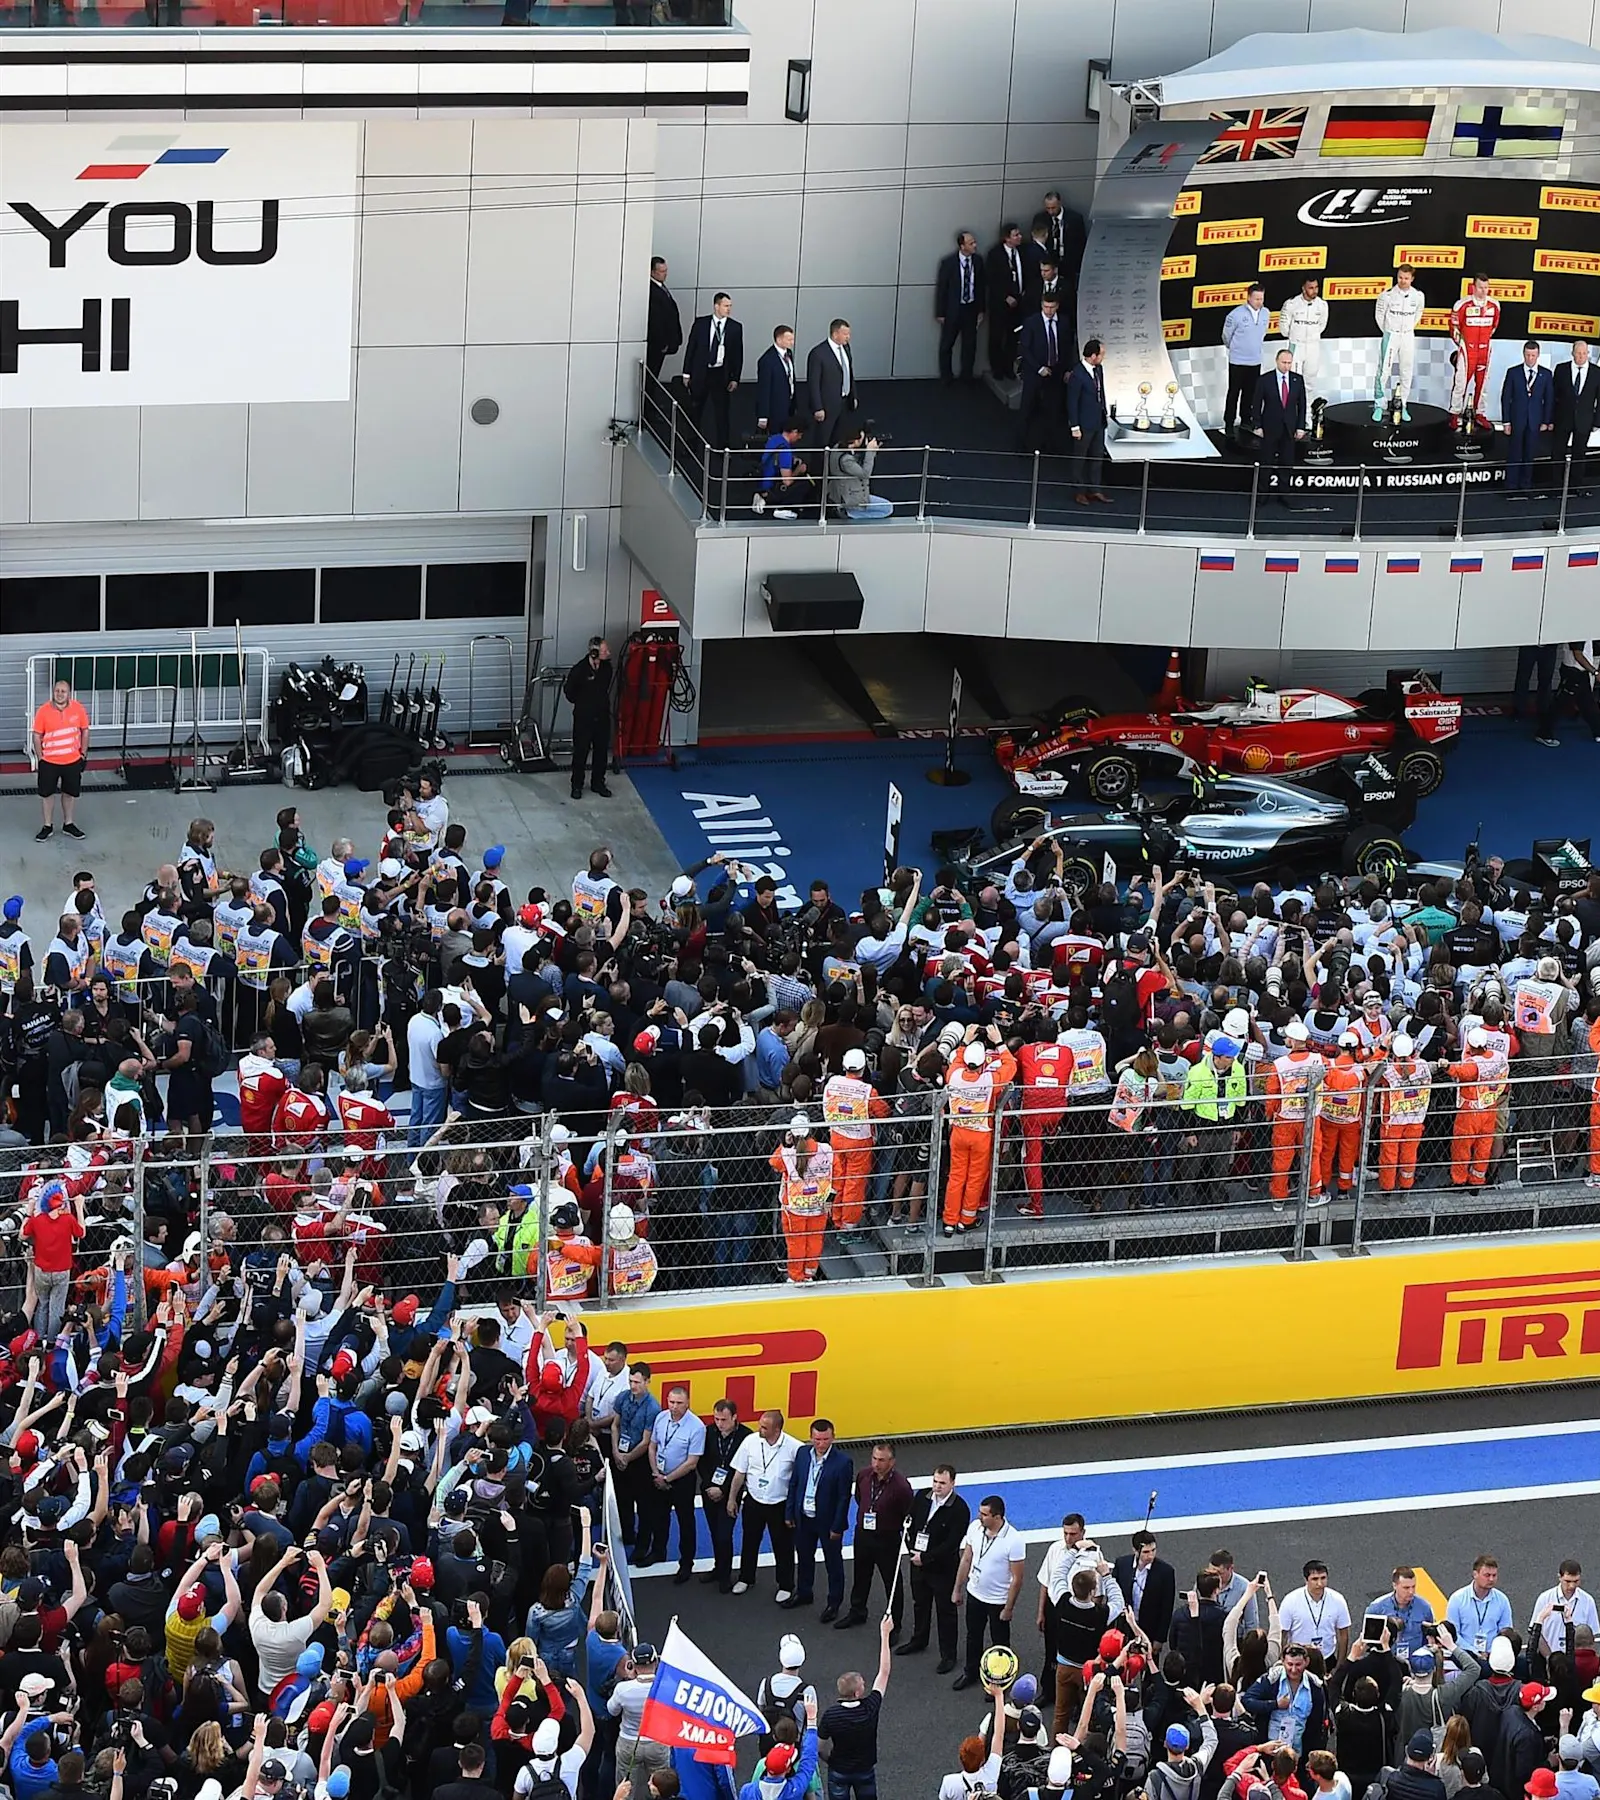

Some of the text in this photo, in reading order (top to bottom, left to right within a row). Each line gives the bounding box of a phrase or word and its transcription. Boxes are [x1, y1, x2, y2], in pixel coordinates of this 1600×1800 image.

[9, 200, 278, 268] YOU
[1203, 223, 1257, 240] PIRELLI
[1473, 220, 1532, 235] PIRELLI
[1265, 251, 1320, 267] PIRELLI
[1400, 250, 1458, 263] PIRELLI
[1541, 254, 1600, 271] PIRELLI
[1198, 286, 1248, 304] PIRELL
[1467, 282, 1526, 297] PRELLI
[1535, 316, 1595, 333] PIRELLI
[1373, 440, 1419, 448] CHANDON
[1376, 475, 1382, 486] 1
[1387, 474, 1444, 486] RUSSIAN
[1446, 471, 1492, 484] GRAND
[653, 600, 668, 613] 2
[1418, 708, 1459, 717] Santander
[1126, 732, 1161, 740] Santander
[1029, 784, 1063, 792] Santander
[1364, 791, 1395, 801] EPSON
[1187, 847, 1255, 860] PETRONAS
[22, 1014, 50, 1031] SAHARA
